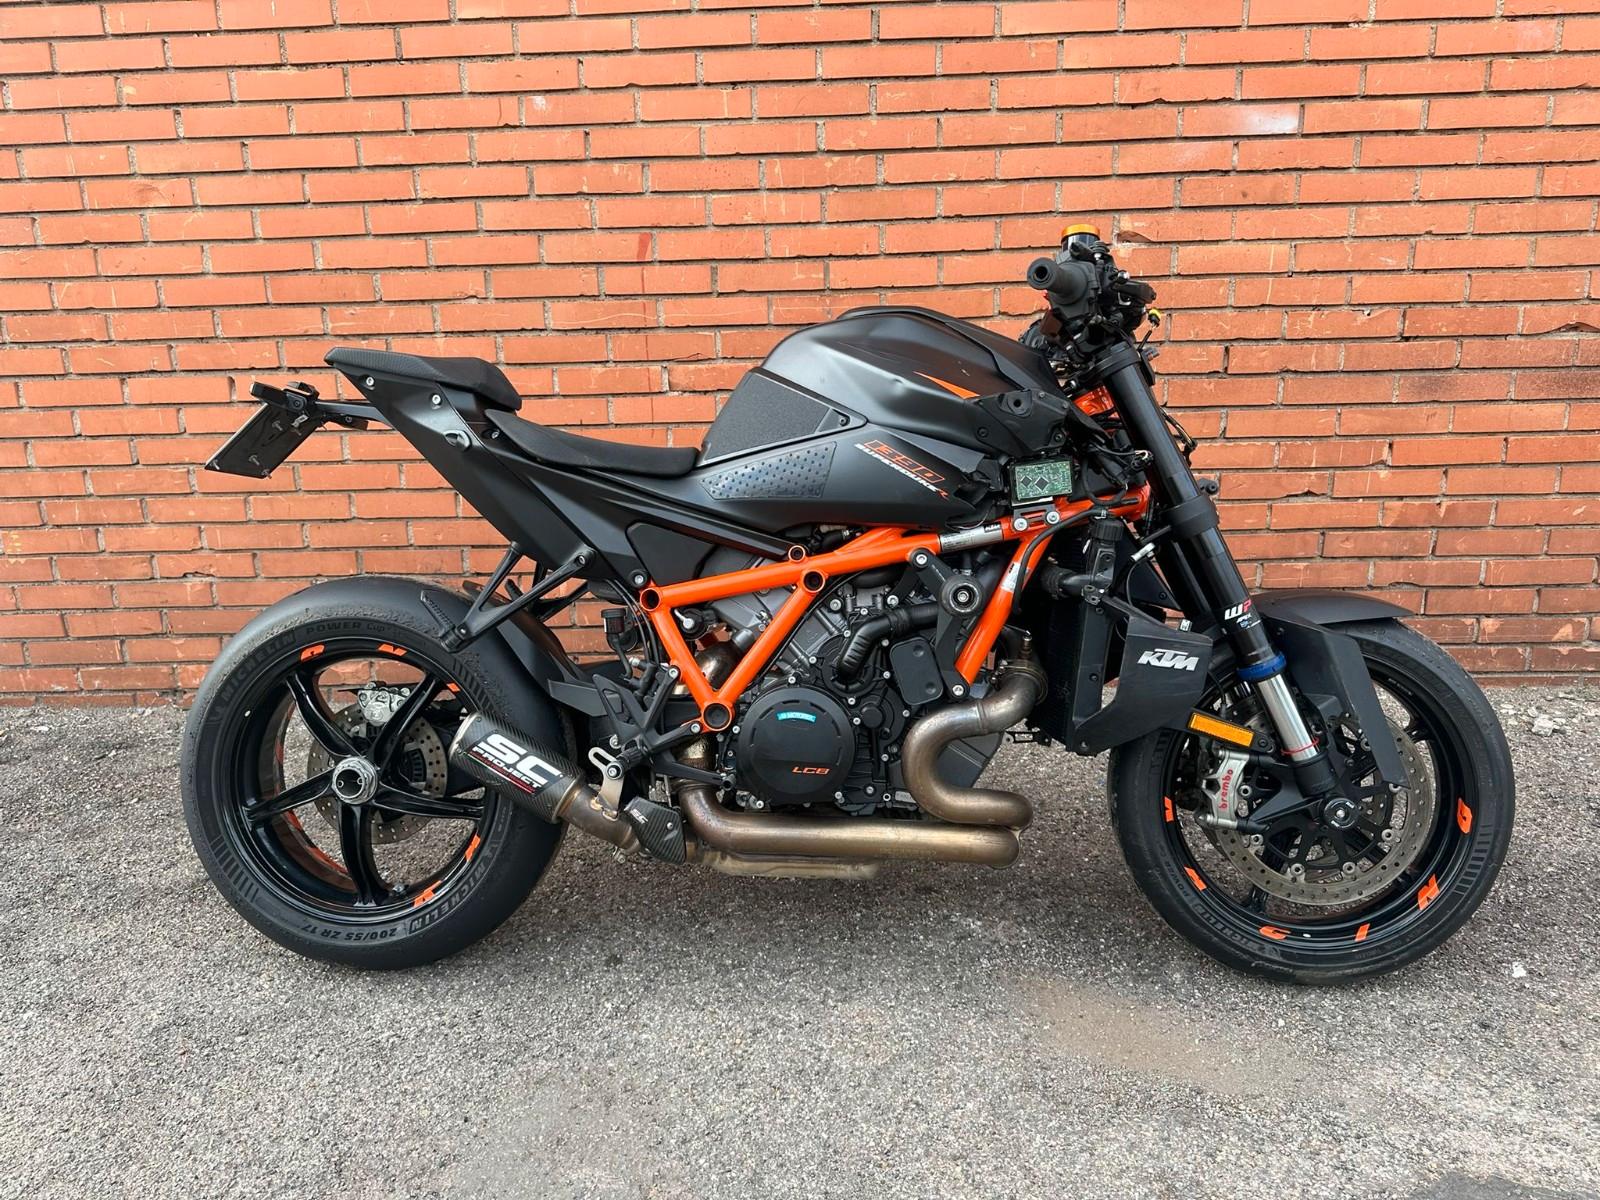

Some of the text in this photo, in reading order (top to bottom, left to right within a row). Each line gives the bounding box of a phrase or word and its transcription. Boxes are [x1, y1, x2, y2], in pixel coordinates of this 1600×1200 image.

[1224, 599, 1252, 620] WP
[221, 632, 296, 702] MICHELIN
[306, 621, 361, 635] POWER
[1137, 648, 1200, 672] KTM
[472, 746, 542, 788] PROJECT
[477, 733, 562, 786] SC
[792, 766, 830, 775] LC8
[1218, 768, 1234, 811] brembo
[301, 863, 487, 942] MICHELIN 200/55 ZR 17
